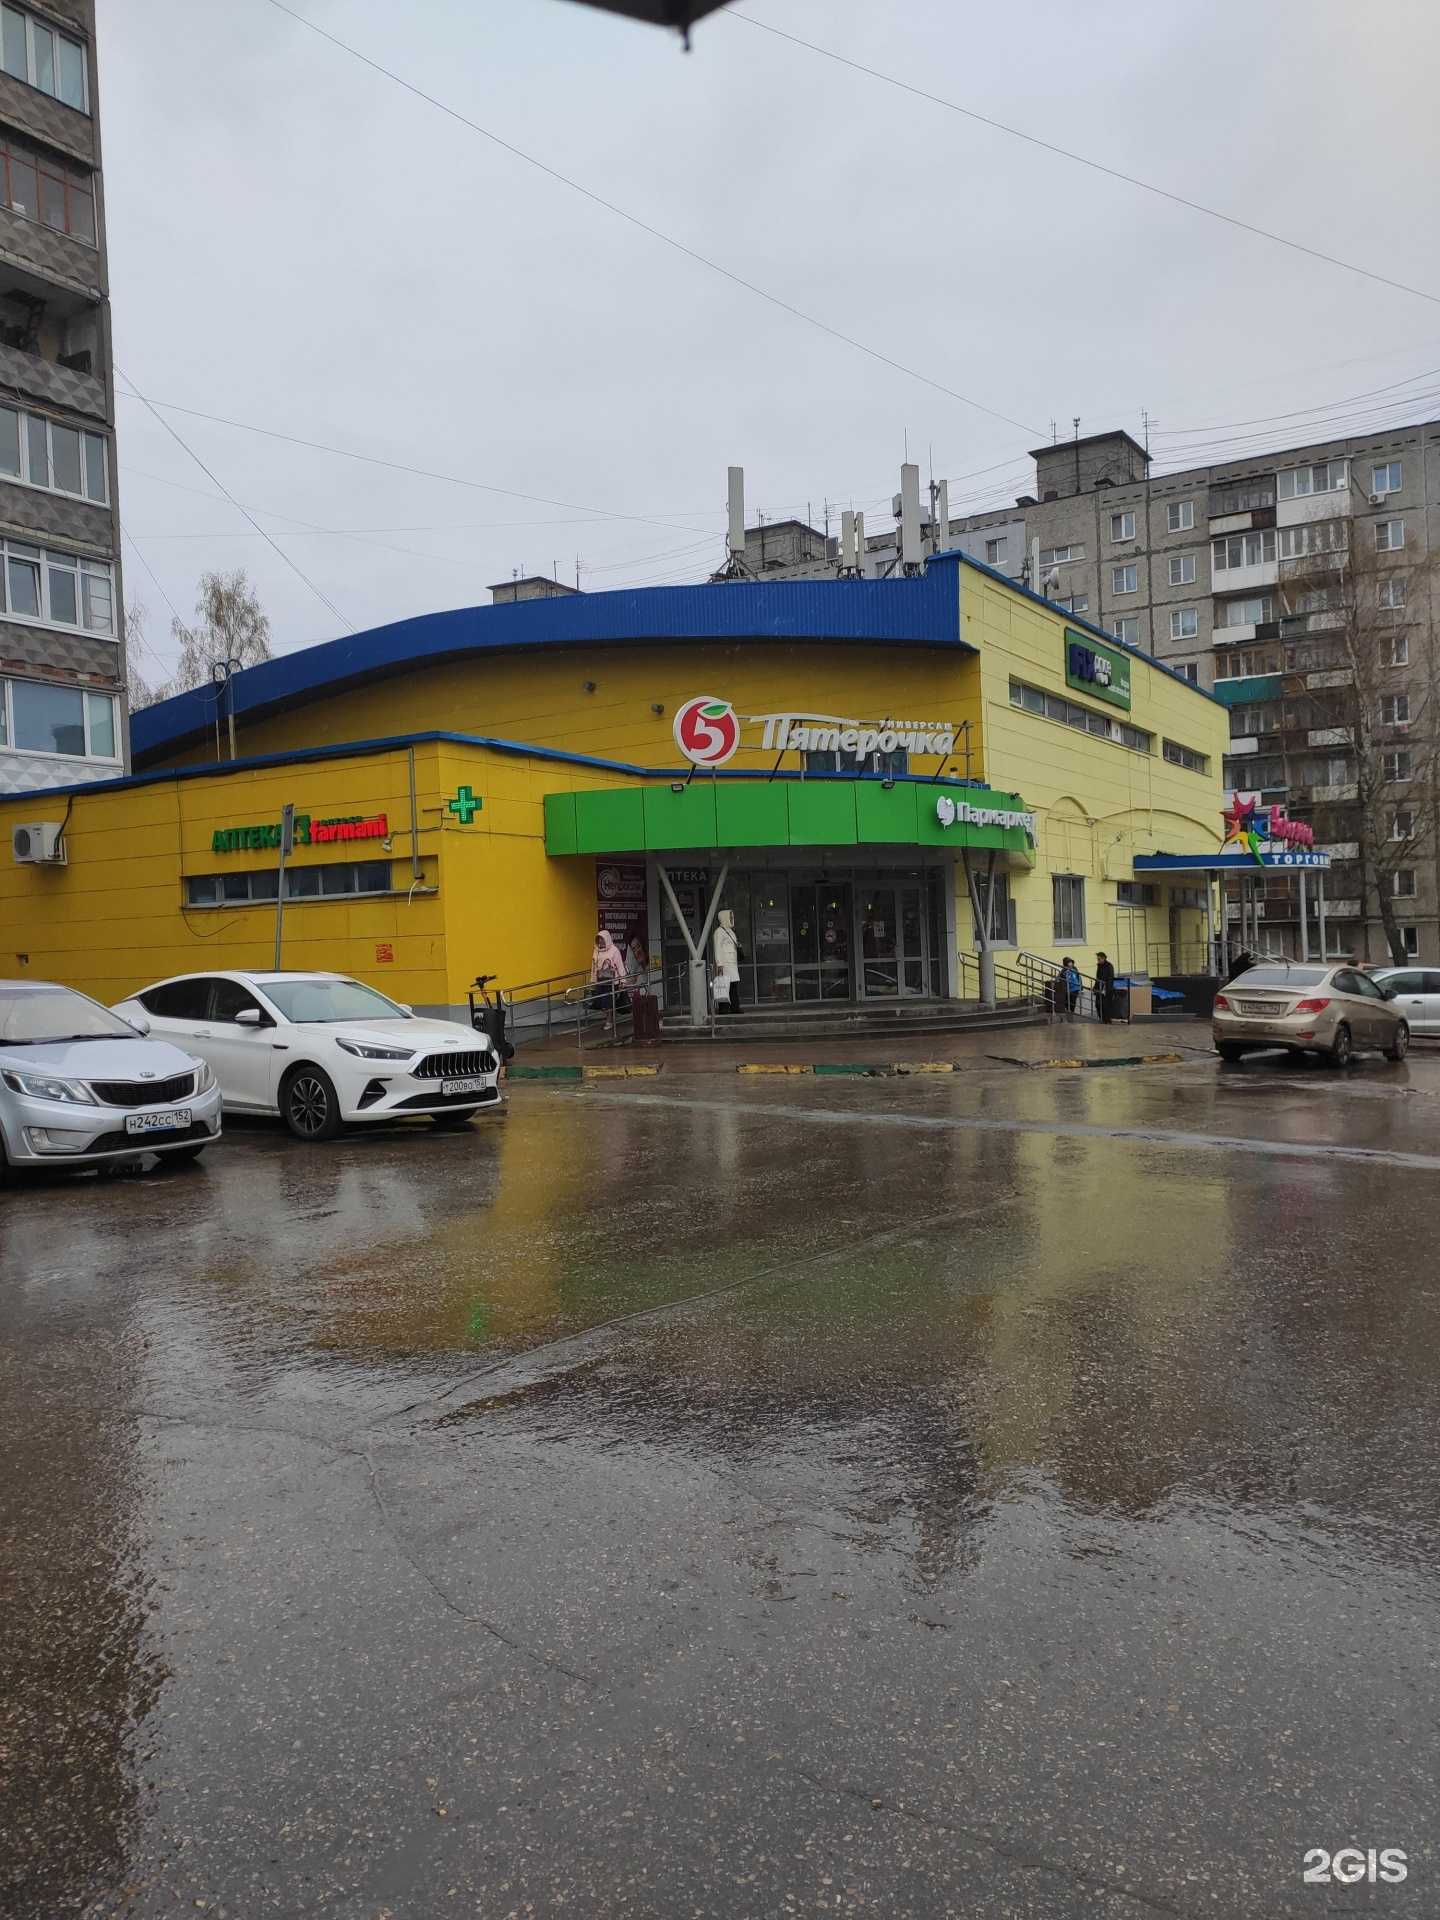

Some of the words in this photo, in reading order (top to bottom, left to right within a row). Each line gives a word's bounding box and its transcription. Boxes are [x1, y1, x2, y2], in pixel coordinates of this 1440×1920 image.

[666, 871, 707, 881] ПТЕКА
[129, 1114, 171, 1129] Н242СС
[174, 1110, 189, 1121] 152
